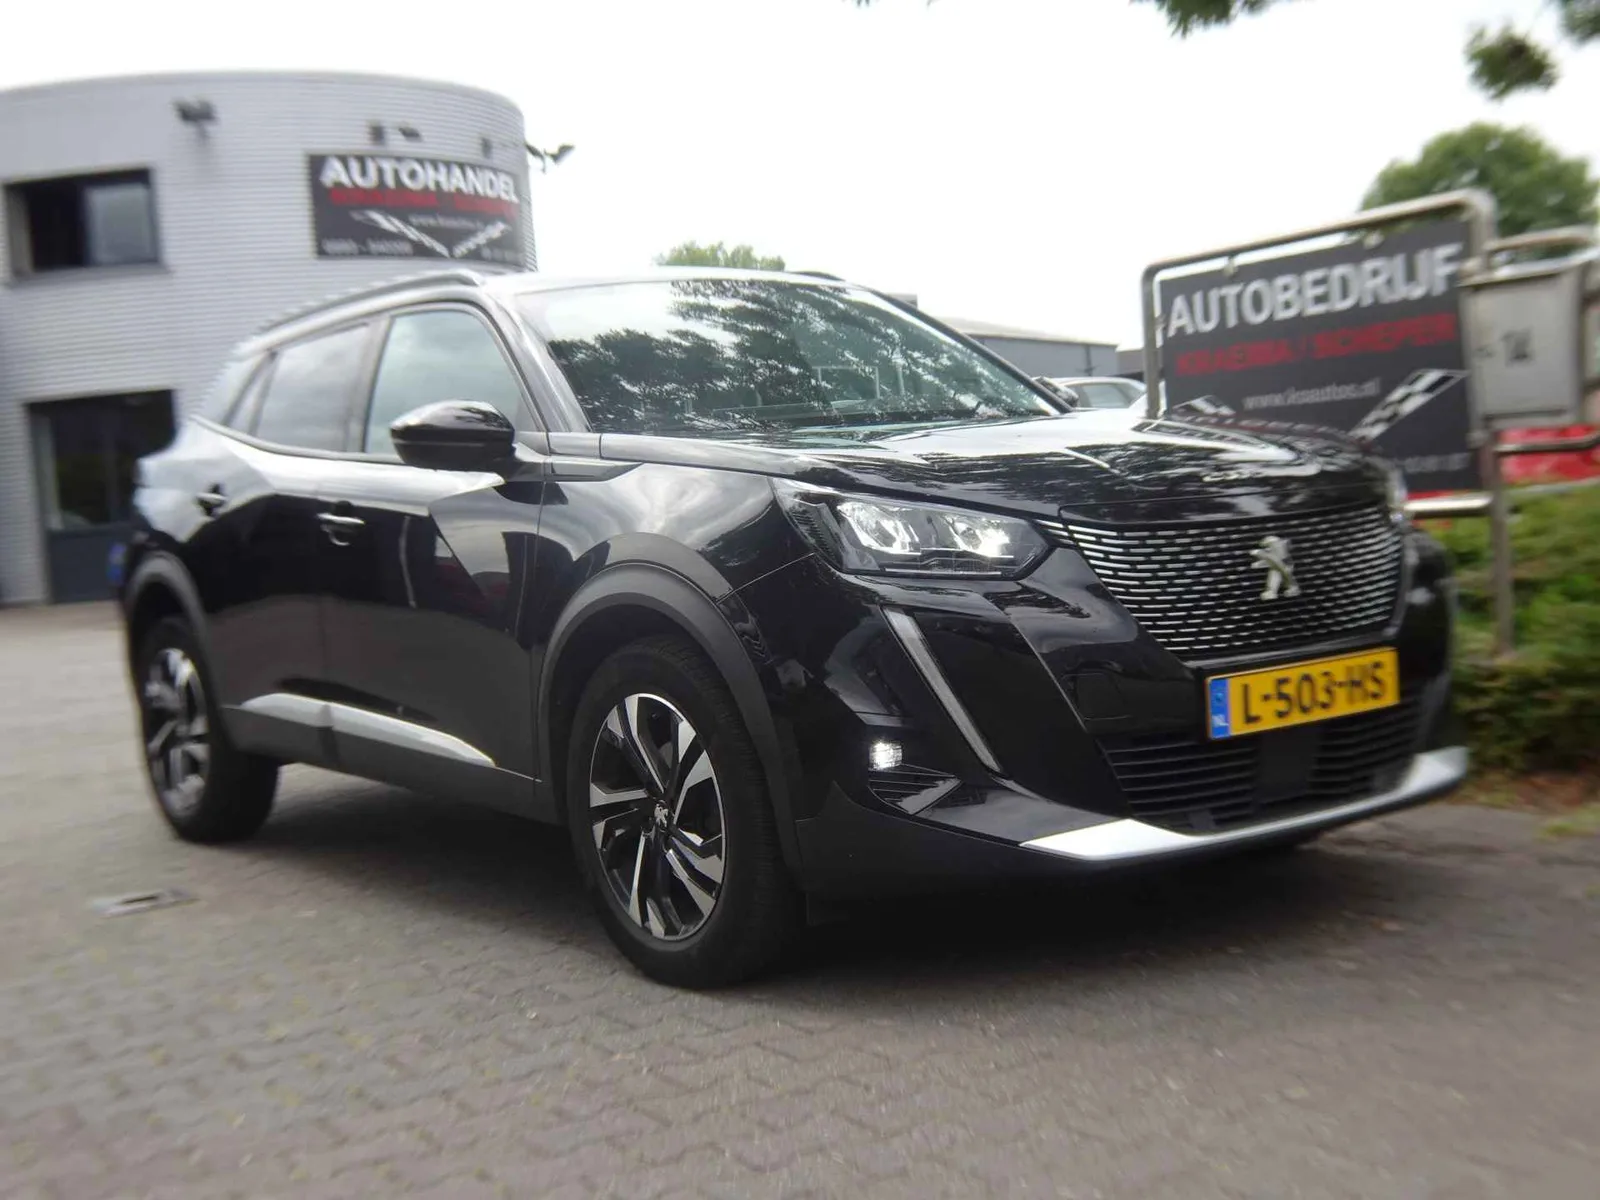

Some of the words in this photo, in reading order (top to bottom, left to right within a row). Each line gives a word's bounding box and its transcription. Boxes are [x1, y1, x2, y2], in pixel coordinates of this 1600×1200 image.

[319, 155, 520, 204] AUTOHANDEL
[1166, 241, 1464, 338] AUTOBEDRIJF
[1241, 661, 1387, 725] L-503-HS
